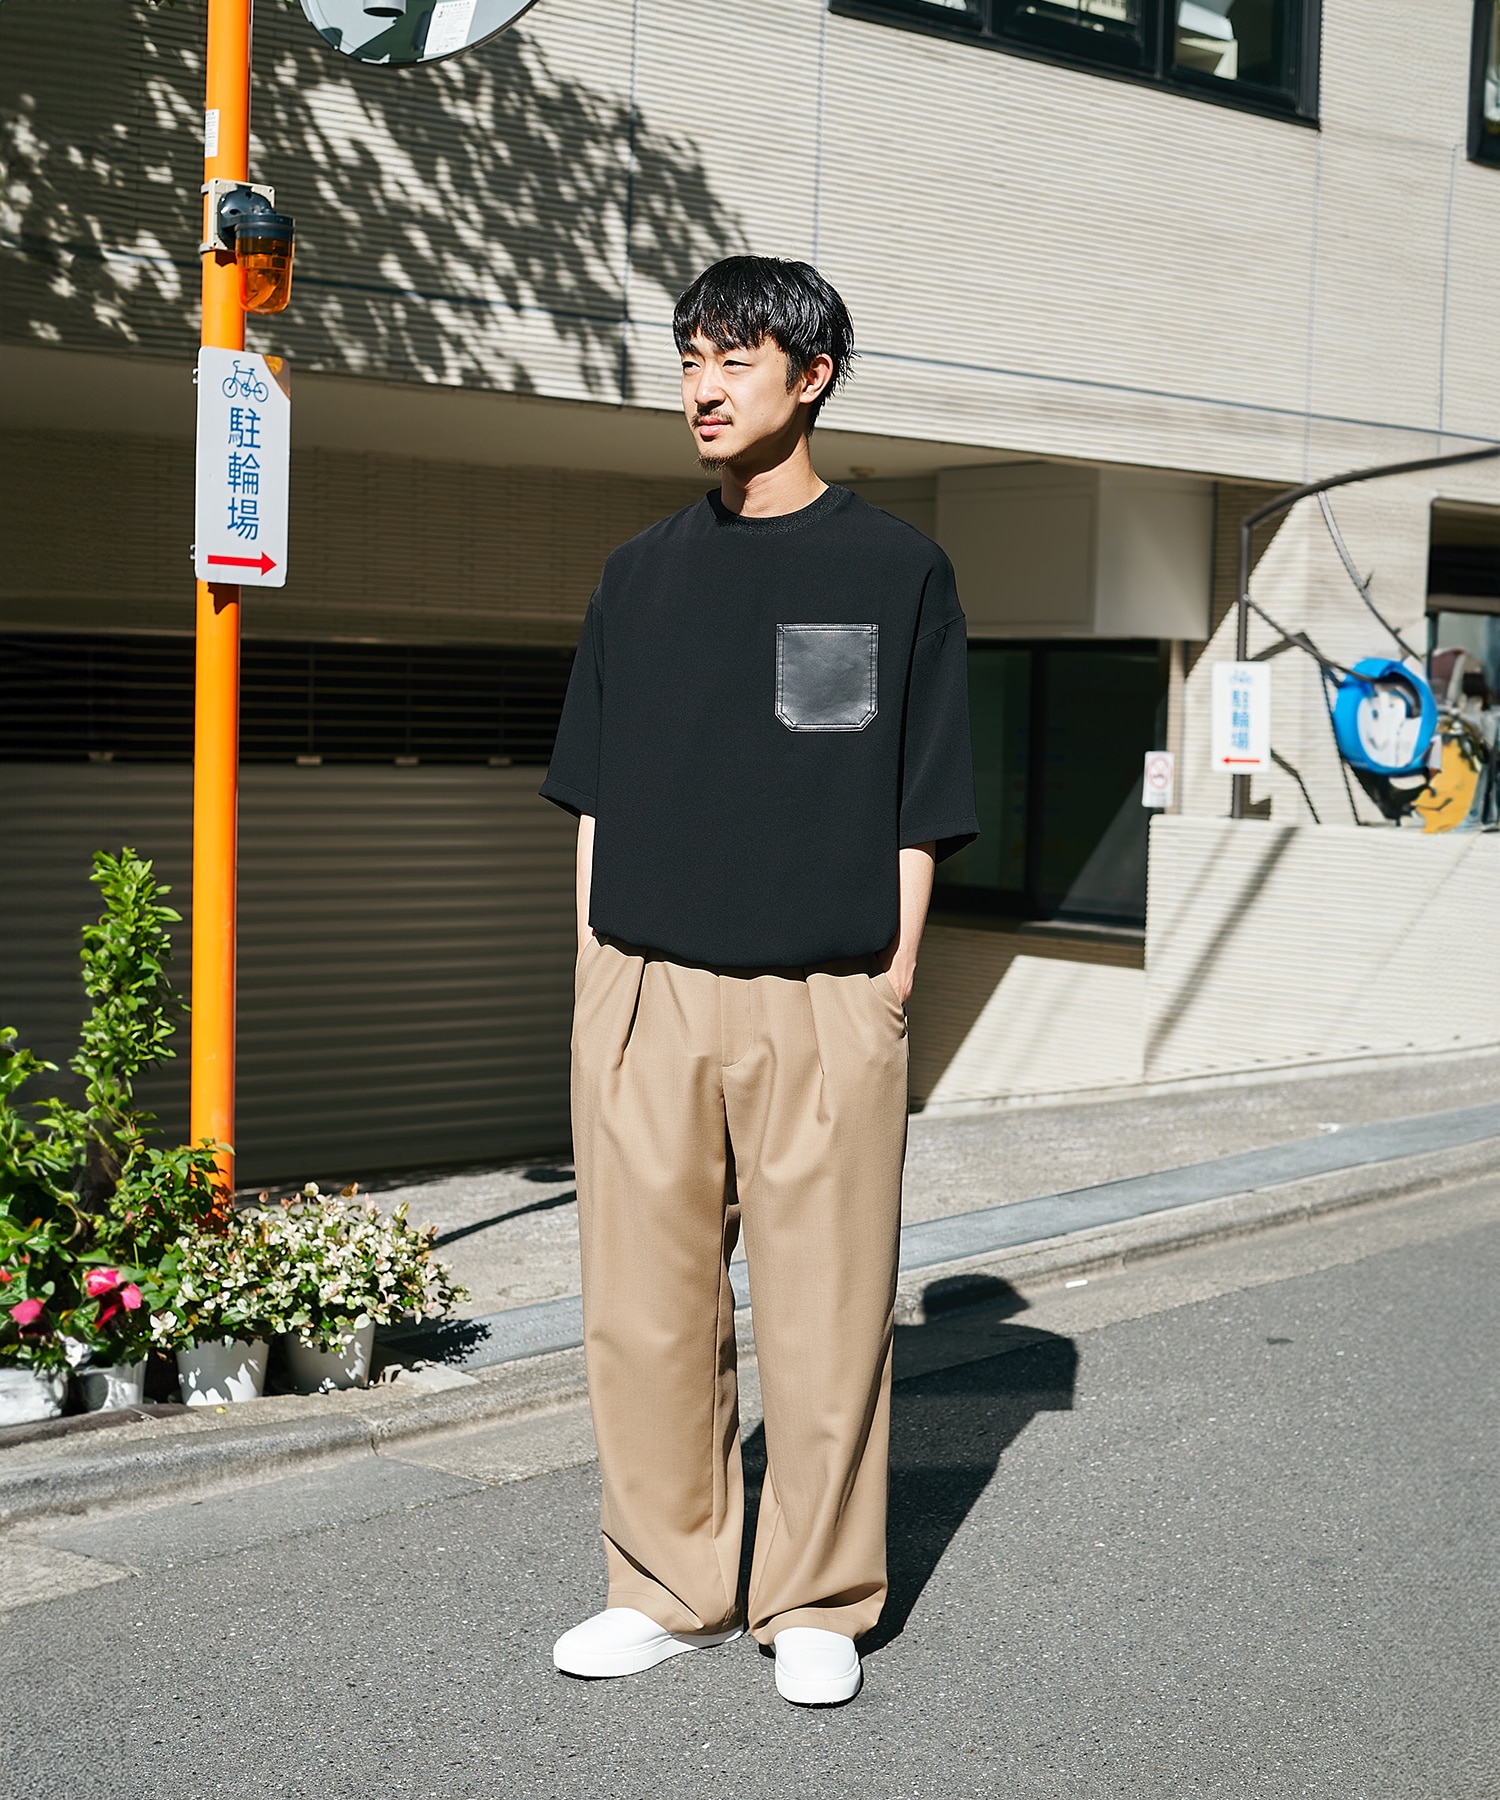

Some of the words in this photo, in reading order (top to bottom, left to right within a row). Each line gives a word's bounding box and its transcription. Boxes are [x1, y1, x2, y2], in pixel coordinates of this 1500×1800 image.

[227, 406, 261, 541] 駐輪場
[1231, 690, 1249, 750] 駐輪場
